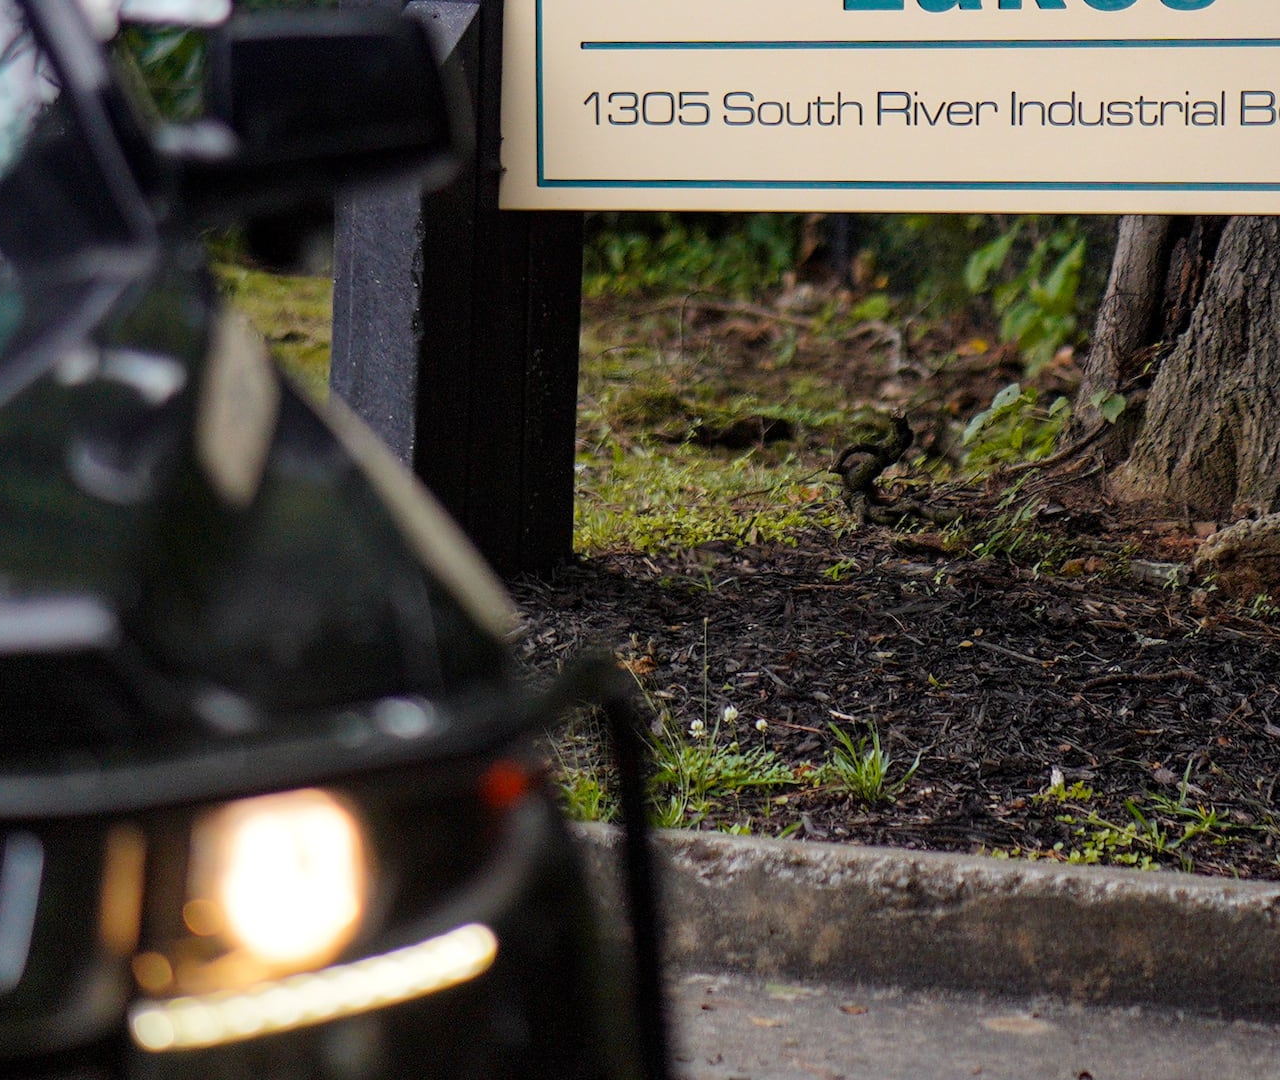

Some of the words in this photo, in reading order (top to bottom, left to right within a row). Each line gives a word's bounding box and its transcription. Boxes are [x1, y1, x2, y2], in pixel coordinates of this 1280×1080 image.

[584, 92, 710, 126] 1305
[723, 92, 863, 126] South
[877, 91, 998, 126] River
[1011, 91, 1225, 126] Industrial
